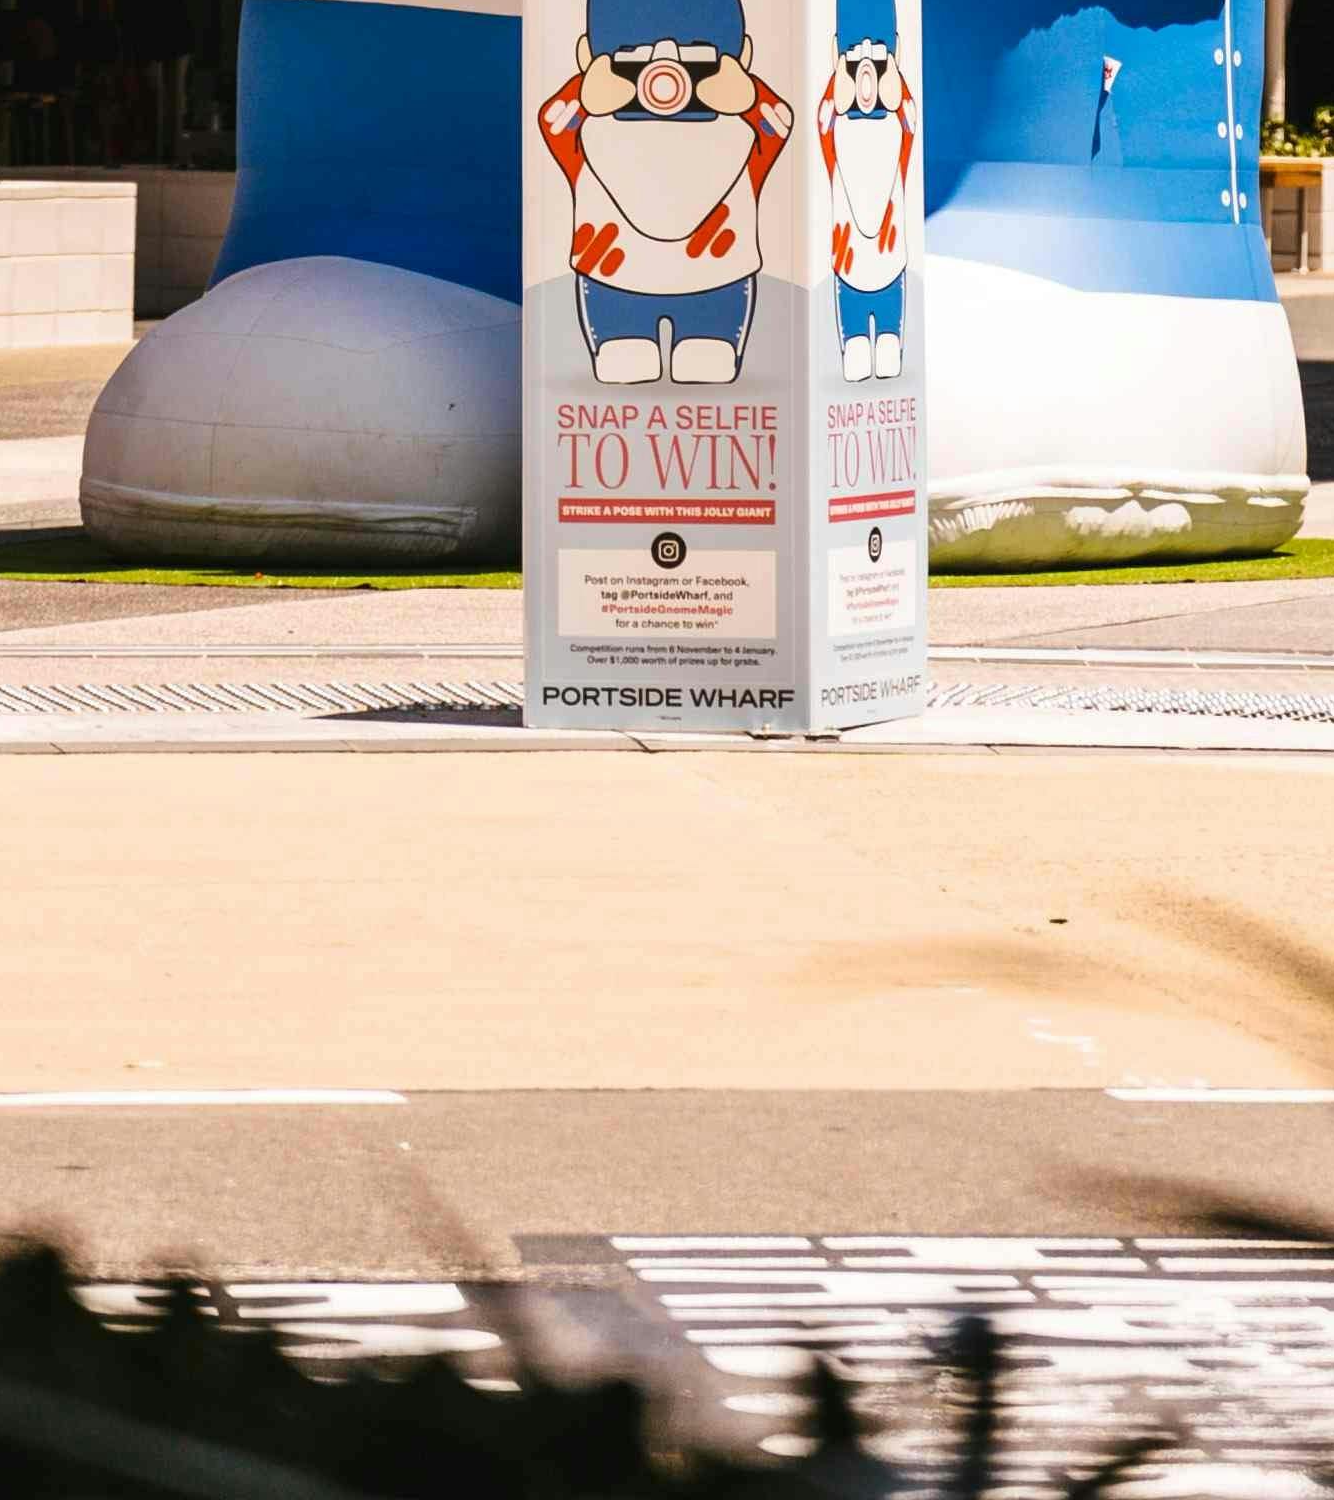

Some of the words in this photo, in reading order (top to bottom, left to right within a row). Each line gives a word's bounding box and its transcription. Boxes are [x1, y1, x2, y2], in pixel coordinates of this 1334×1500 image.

[557, 404, 639, 429] SNAP
[647, 405, 668, 429] A
[676, 405, 778, 430] SELFIE
[827, 402, 864, 428] SNAP
[867, 402, 875, 425] A
[878, 398, 915, 424] SELFIE
[557, 433, 630, 490] TO
[645, 433, 777, 490] WIN!
[827, 431, 860, 487] TO
[867, 426, 916, 484] WIN!
[562, 505, 602, 516] STRIKE
[603, 505, 614, 516] A
[615, 505, 640, 516] POSE
[644, 505, 675, 517] WITH
[677, 506, 702, 517] THIS
[703, 506, 735, 517] JOLLY
[736, 506, 772, 518] GIANT
[584, 575, 608, 585] Post
[610, 578, 624, 586] on
[626, 575, 679, 588] Instagram
[681, 578, 693, 586] or
[695, 576, 750, 587] Facebook,
[601, 591, 618, 602] tag
[713, 592, 733, 600] and
[602, 605, 733, 616] #PortsideGnomeMagic
[616, 619, 631, 628] for
[641, 619, 680, 629] chance
[682, 620, 693, 629] to
[570, 644, 624, 654] Competition
[647, 645, 668, 653] from
[677, 645, 723, 654] November
[724, 646, 734, 654] to
[587, 656, 608, 664] Over
[641, 656, 667, 665] worth
[668, 656, 677, 665] of
[679, 657, 705, 667] prizes
[707, 658, 719, 667] up
[720, 657, 733, 665] for
[821, 682, 877, 707] PORTSIDE
[880, 674, 921, 699] WHARF
[542, 687, 682, 707] PORTSIDE
[689, 688, 795, 709] WHARF
